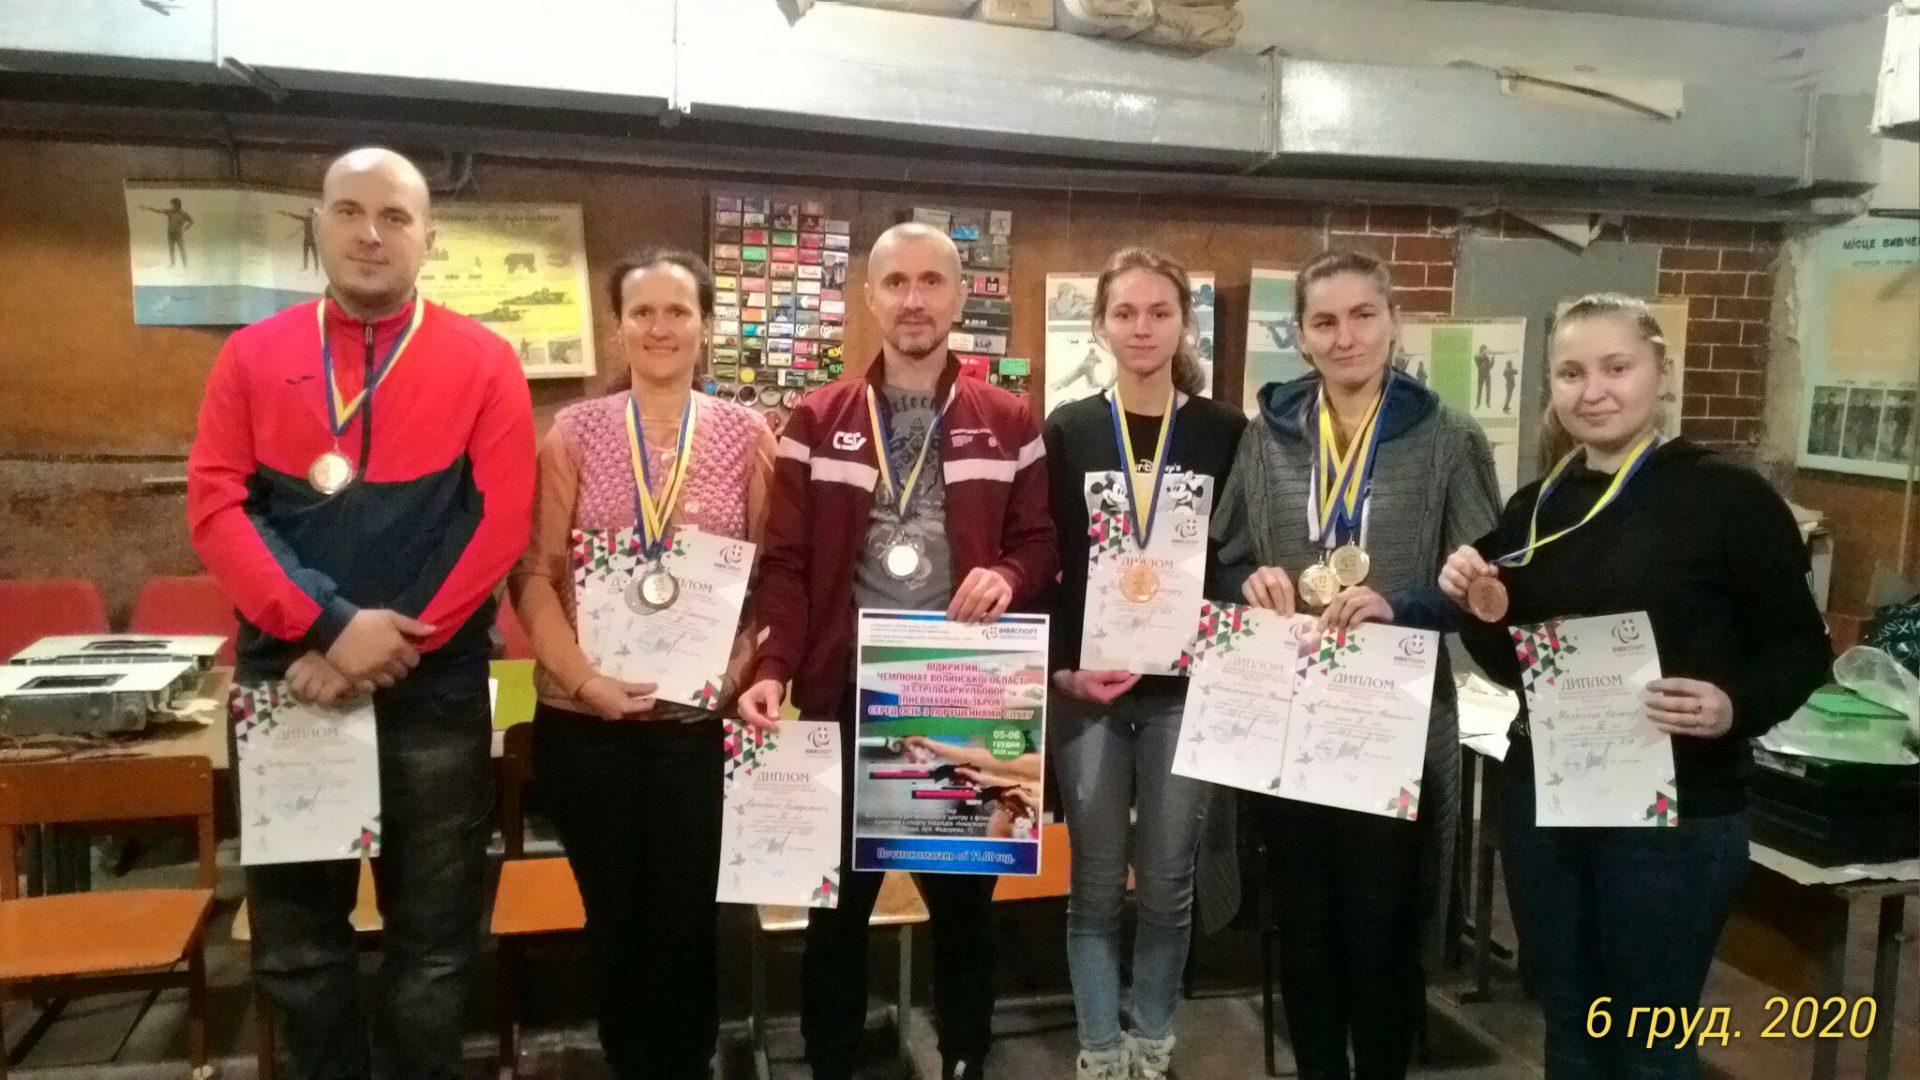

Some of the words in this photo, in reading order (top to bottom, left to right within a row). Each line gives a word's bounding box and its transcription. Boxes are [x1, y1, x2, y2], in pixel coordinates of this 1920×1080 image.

[1843, 239, 1876, 251] МІСЦЕ
[1333, 673, 1395, 690] ДИПЛОМ
[1562, 674, 1624, 690] ДИПЛОМ
[993, 730, 1020, 740] 05-06
[757, 771, 810, 784] ДИПЛОМ
